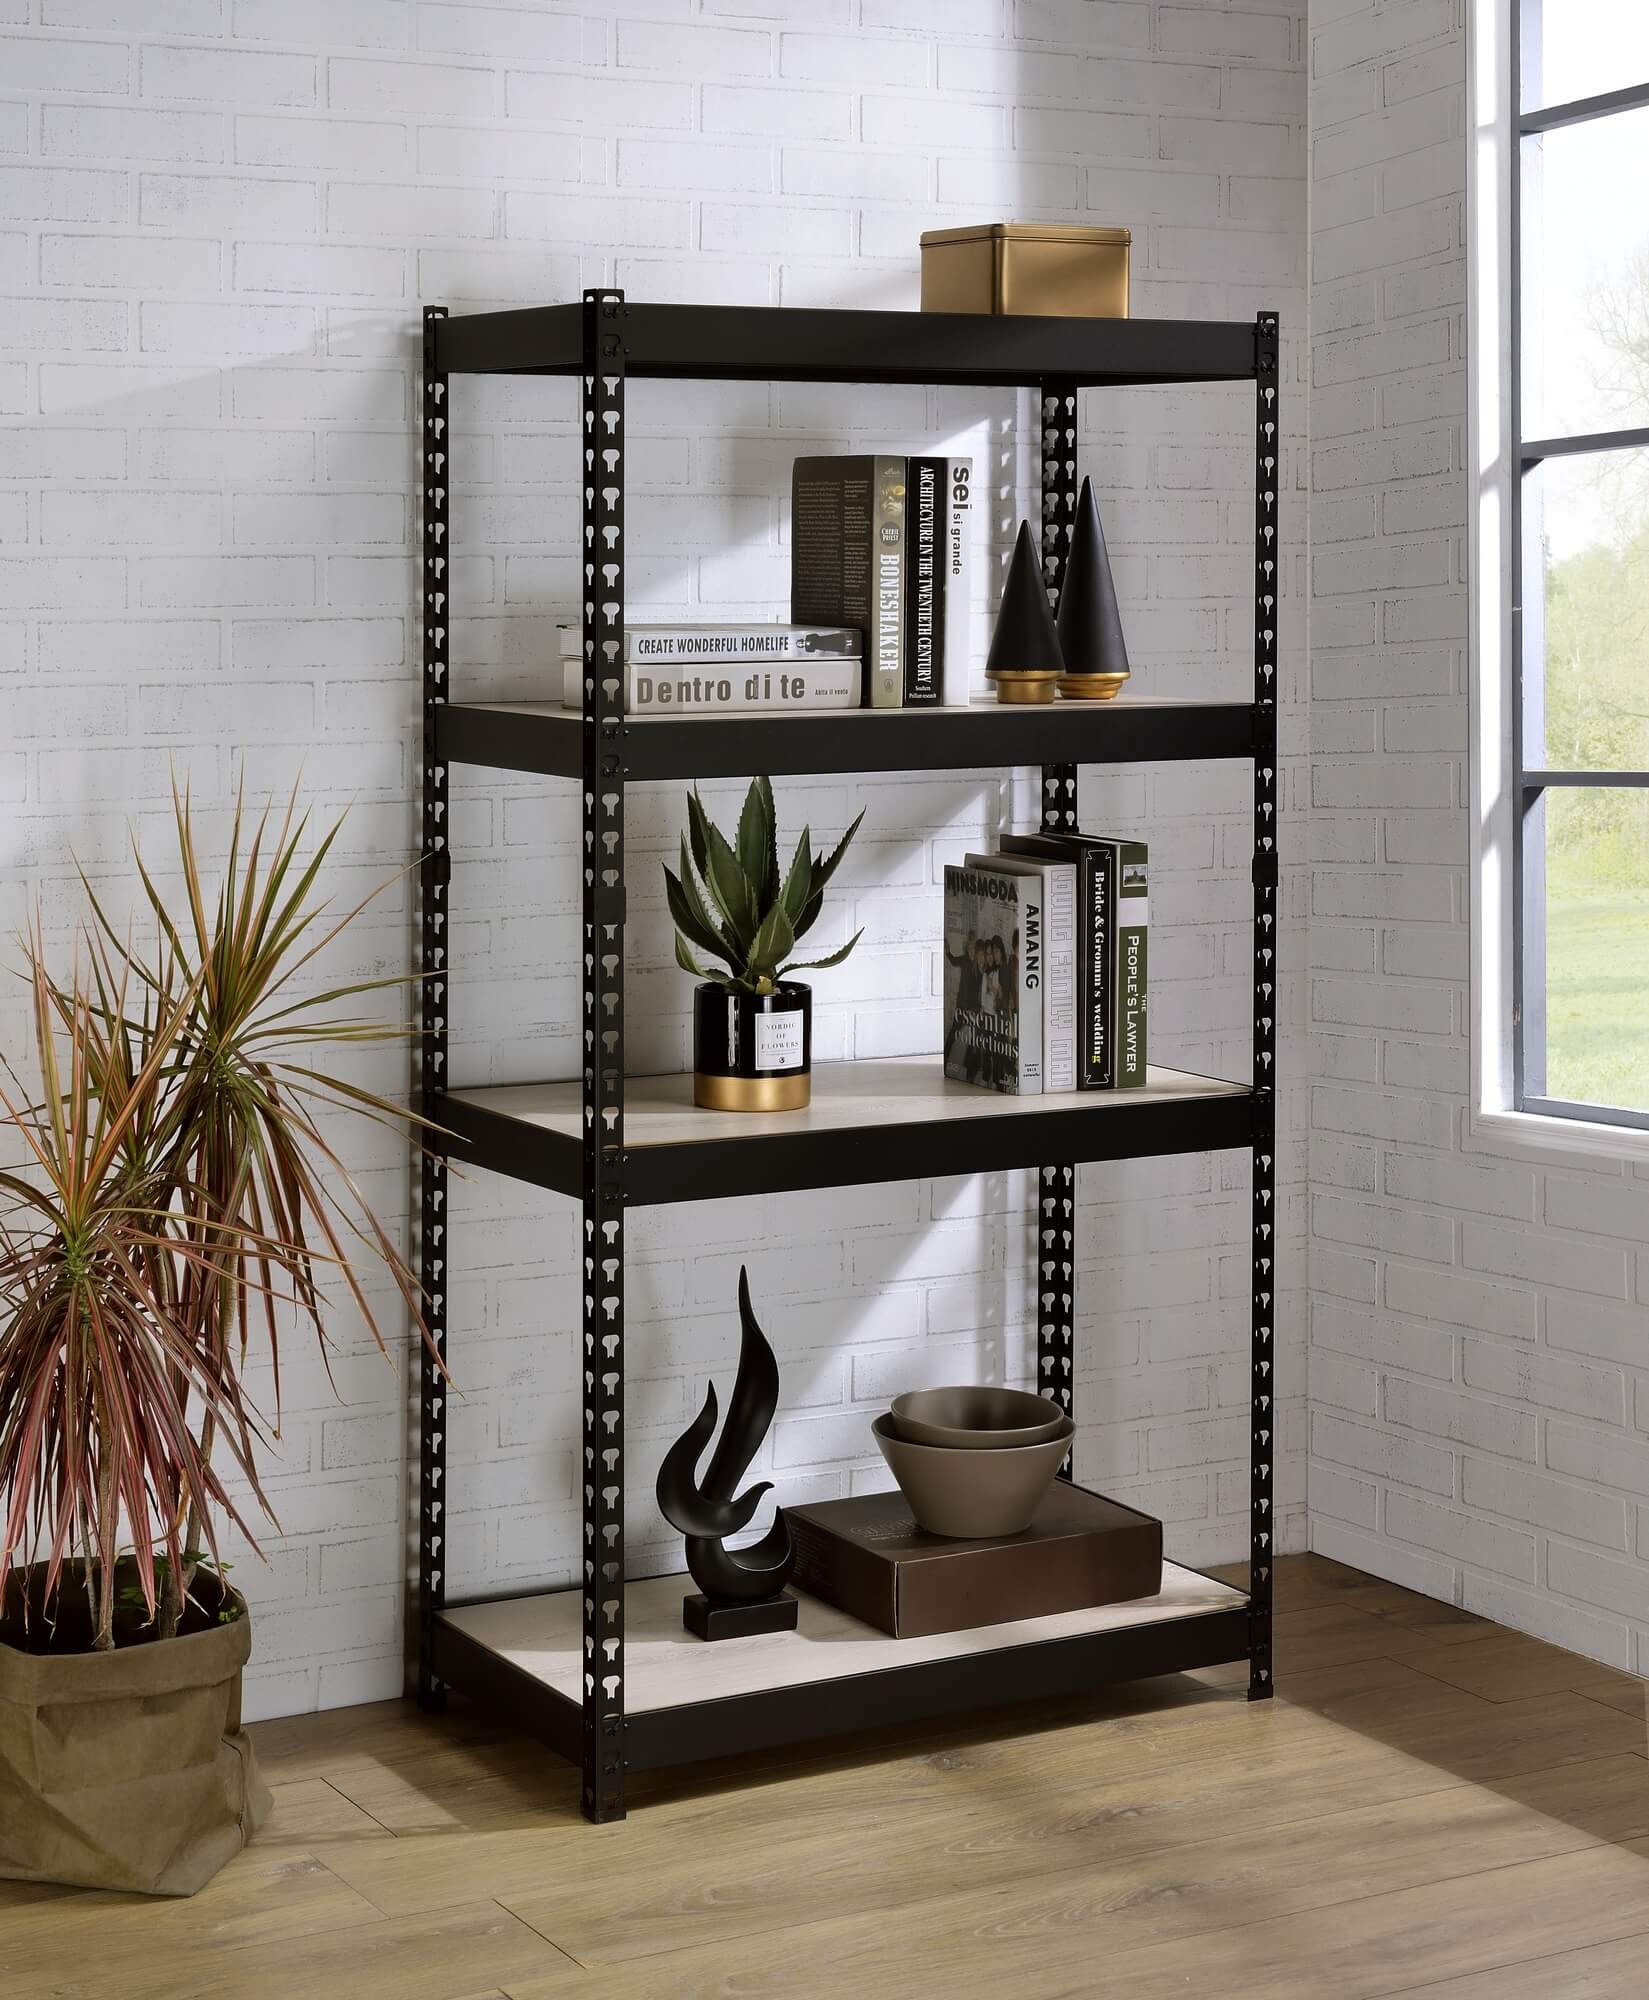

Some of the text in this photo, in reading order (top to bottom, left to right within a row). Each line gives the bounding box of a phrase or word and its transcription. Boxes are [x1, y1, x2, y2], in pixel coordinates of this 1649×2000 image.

[950, 466, 972, 575] sei si grande
[919, 557, 933, 576] THE
[920, 544, 934, 555] IN
[880, 554, 900, 671] BONESHAKER
[918, 578, 933, 635] TWENTIETH
[638, 636, 789, 654] CREATE WONDERFUL HOMELIFE
[917, 637, 932, 683] CENTURY
[637, 674, 805, 704] Dentro di te
[1095, 871, 1105, 913] Bride
[1095, 915, 1105, 929] &
[1025, 904, 1040, 989] AMANG
[1051, 950, 1073, 1029] FAMILY
[1126, 935, 1140, 1072] PEOPLE'S LAWYER
[954, 1007, 1018, 1038] essential
[954, 1025, 1019, 1058] collections
[1092, 1003, 1105, 1064] wedding
[1051, 1039, 1073, 1087] MAN
